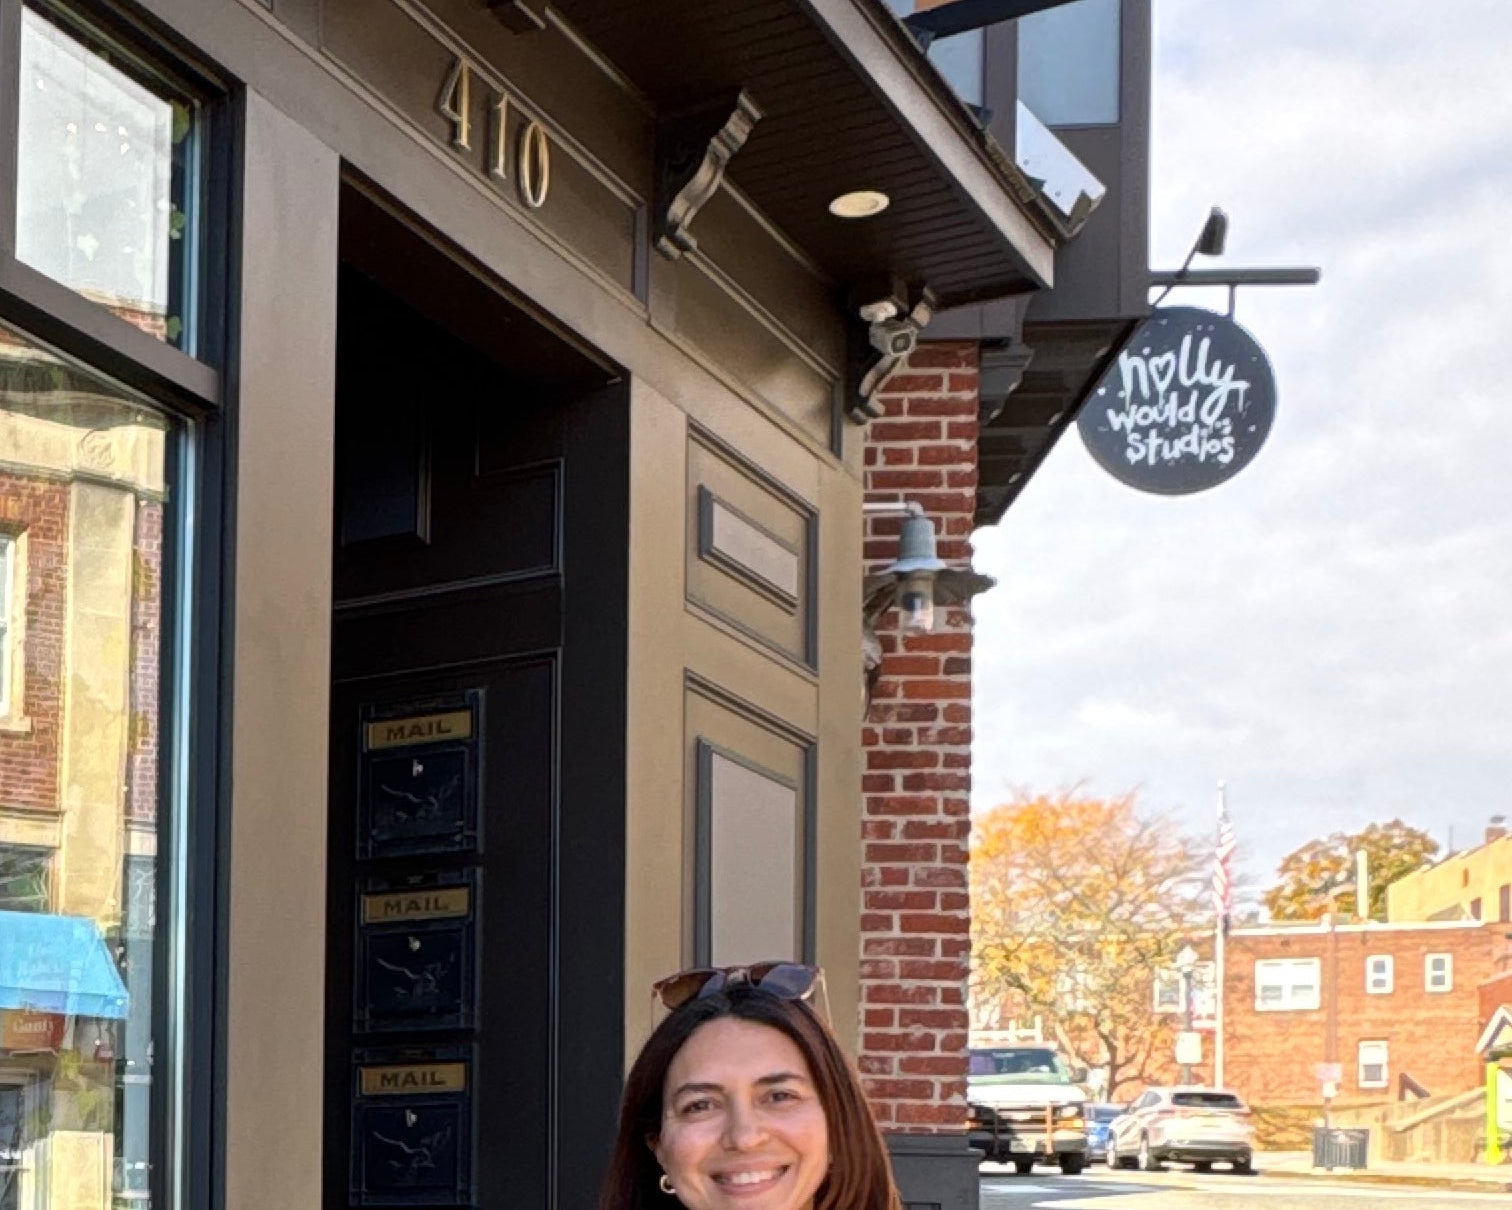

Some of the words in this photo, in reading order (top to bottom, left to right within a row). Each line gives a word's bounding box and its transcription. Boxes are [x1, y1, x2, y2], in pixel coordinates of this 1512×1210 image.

[439, 59, 550, 208] 410
[386, 719, 452, 741] MAIL
[383, 896, 451, 915] MAIL
[380, 1071, 447, 1088] MAIL
